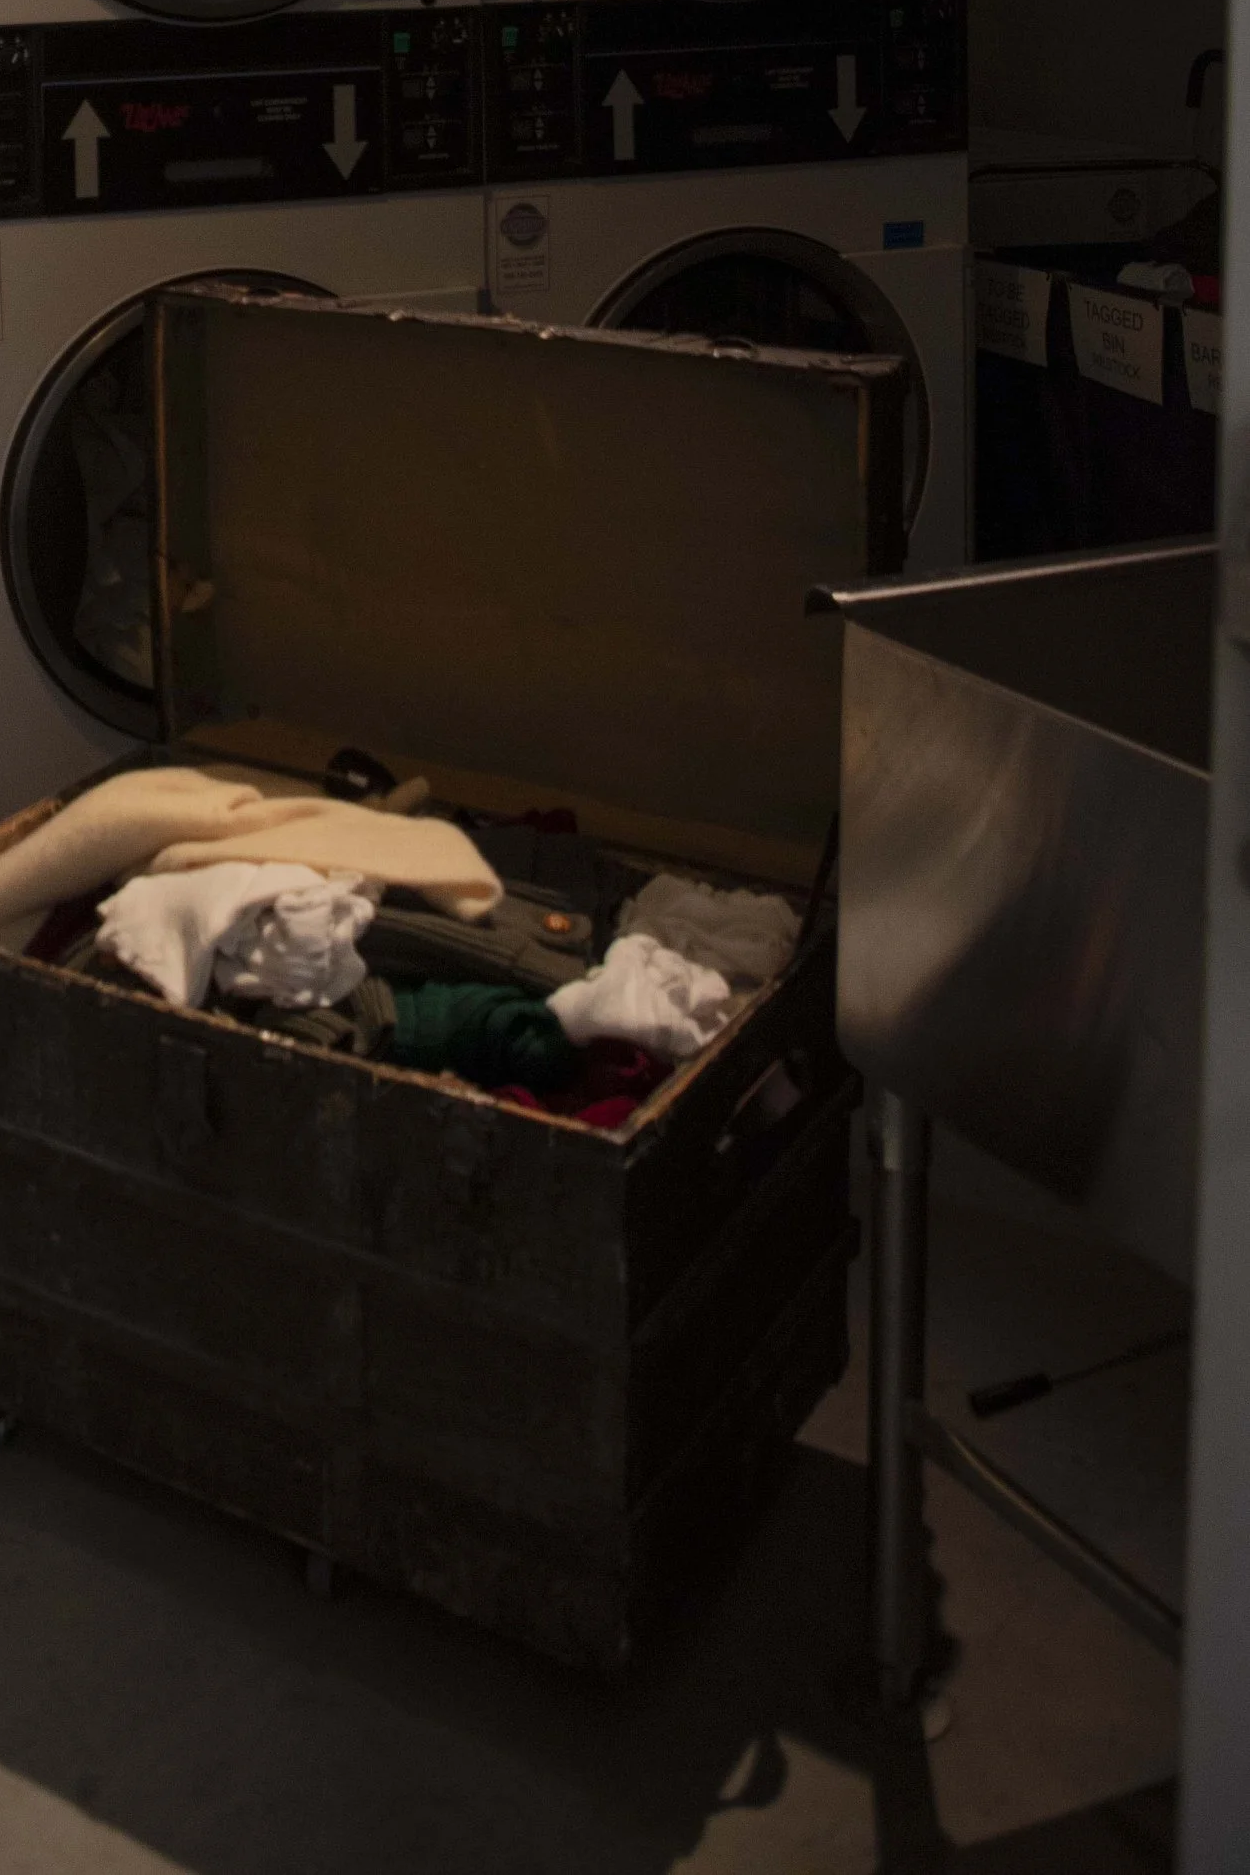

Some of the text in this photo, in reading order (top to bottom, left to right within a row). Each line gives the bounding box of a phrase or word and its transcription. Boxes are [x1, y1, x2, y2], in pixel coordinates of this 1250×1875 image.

[987, 278, 1025, 302] TO BE
[1083, 297, 1143, 332] TAGGED
[1102, 331, 1125, 355] BIN
